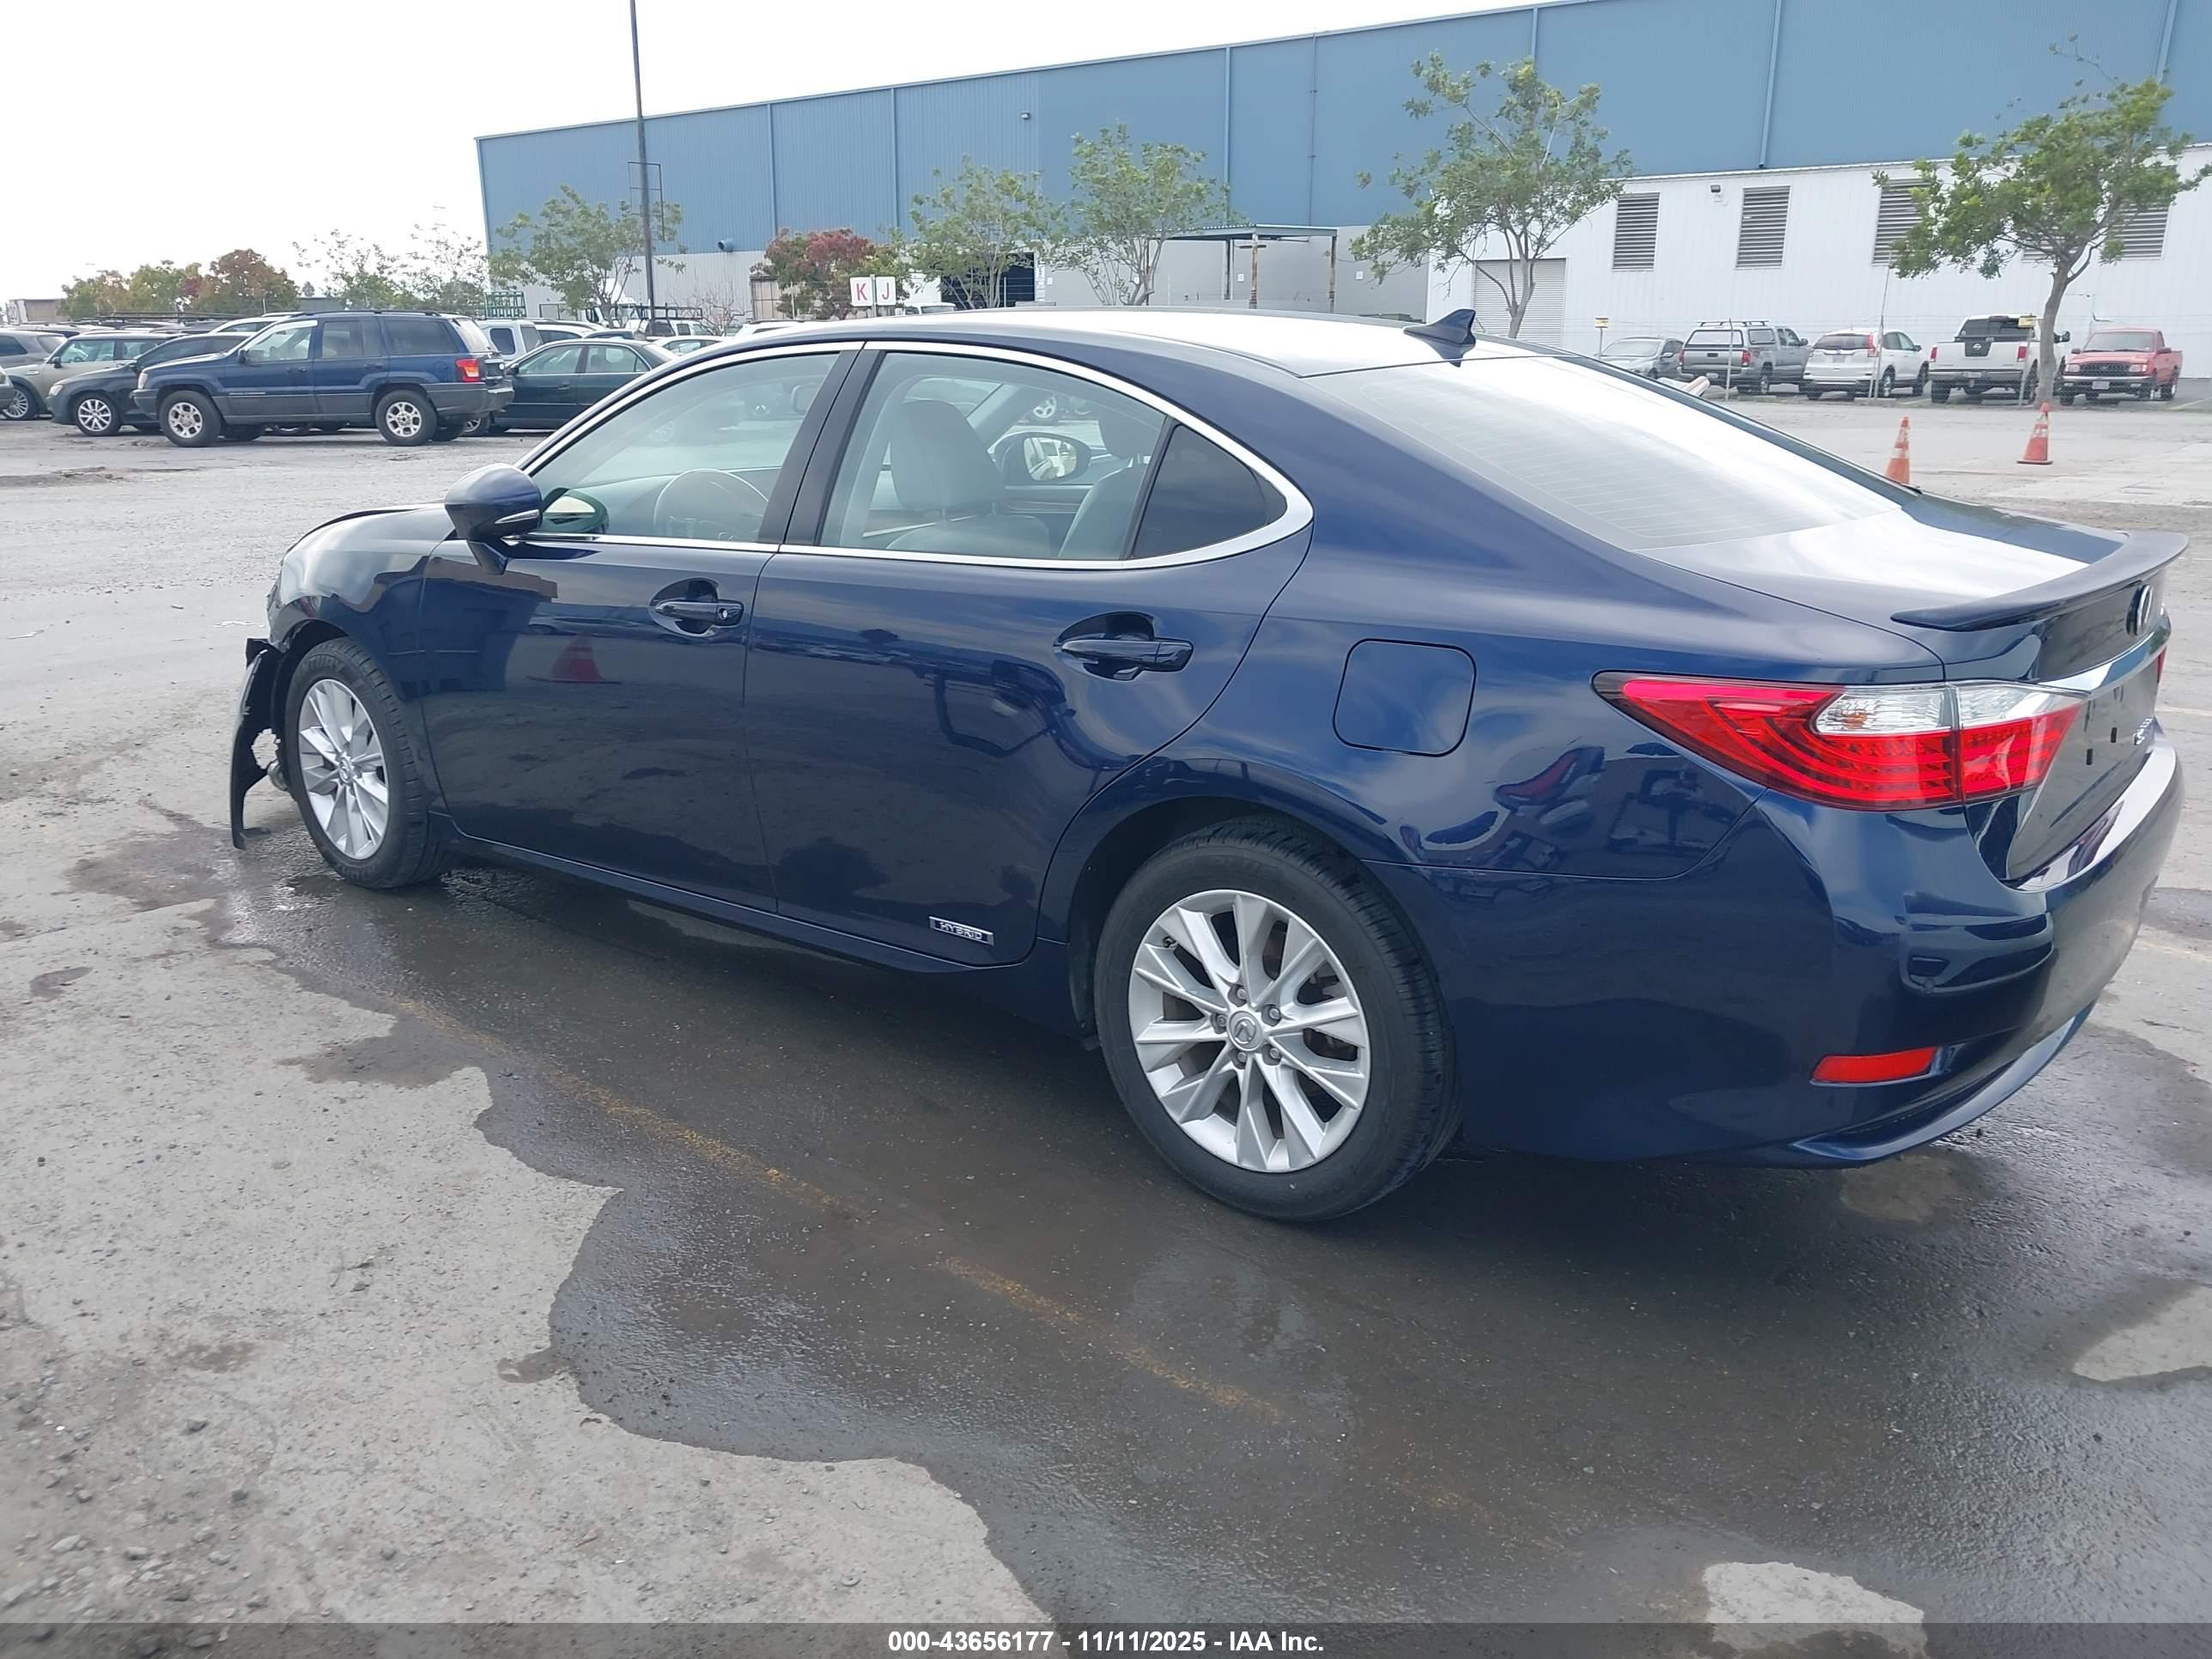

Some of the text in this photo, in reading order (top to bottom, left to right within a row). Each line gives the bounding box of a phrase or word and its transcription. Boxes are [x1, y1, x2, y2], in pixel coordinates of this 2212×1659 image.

[856, 283, 867, 301] K
[881, 283, 890, 300] J
[939, 921, 983, 940] HYBRID
